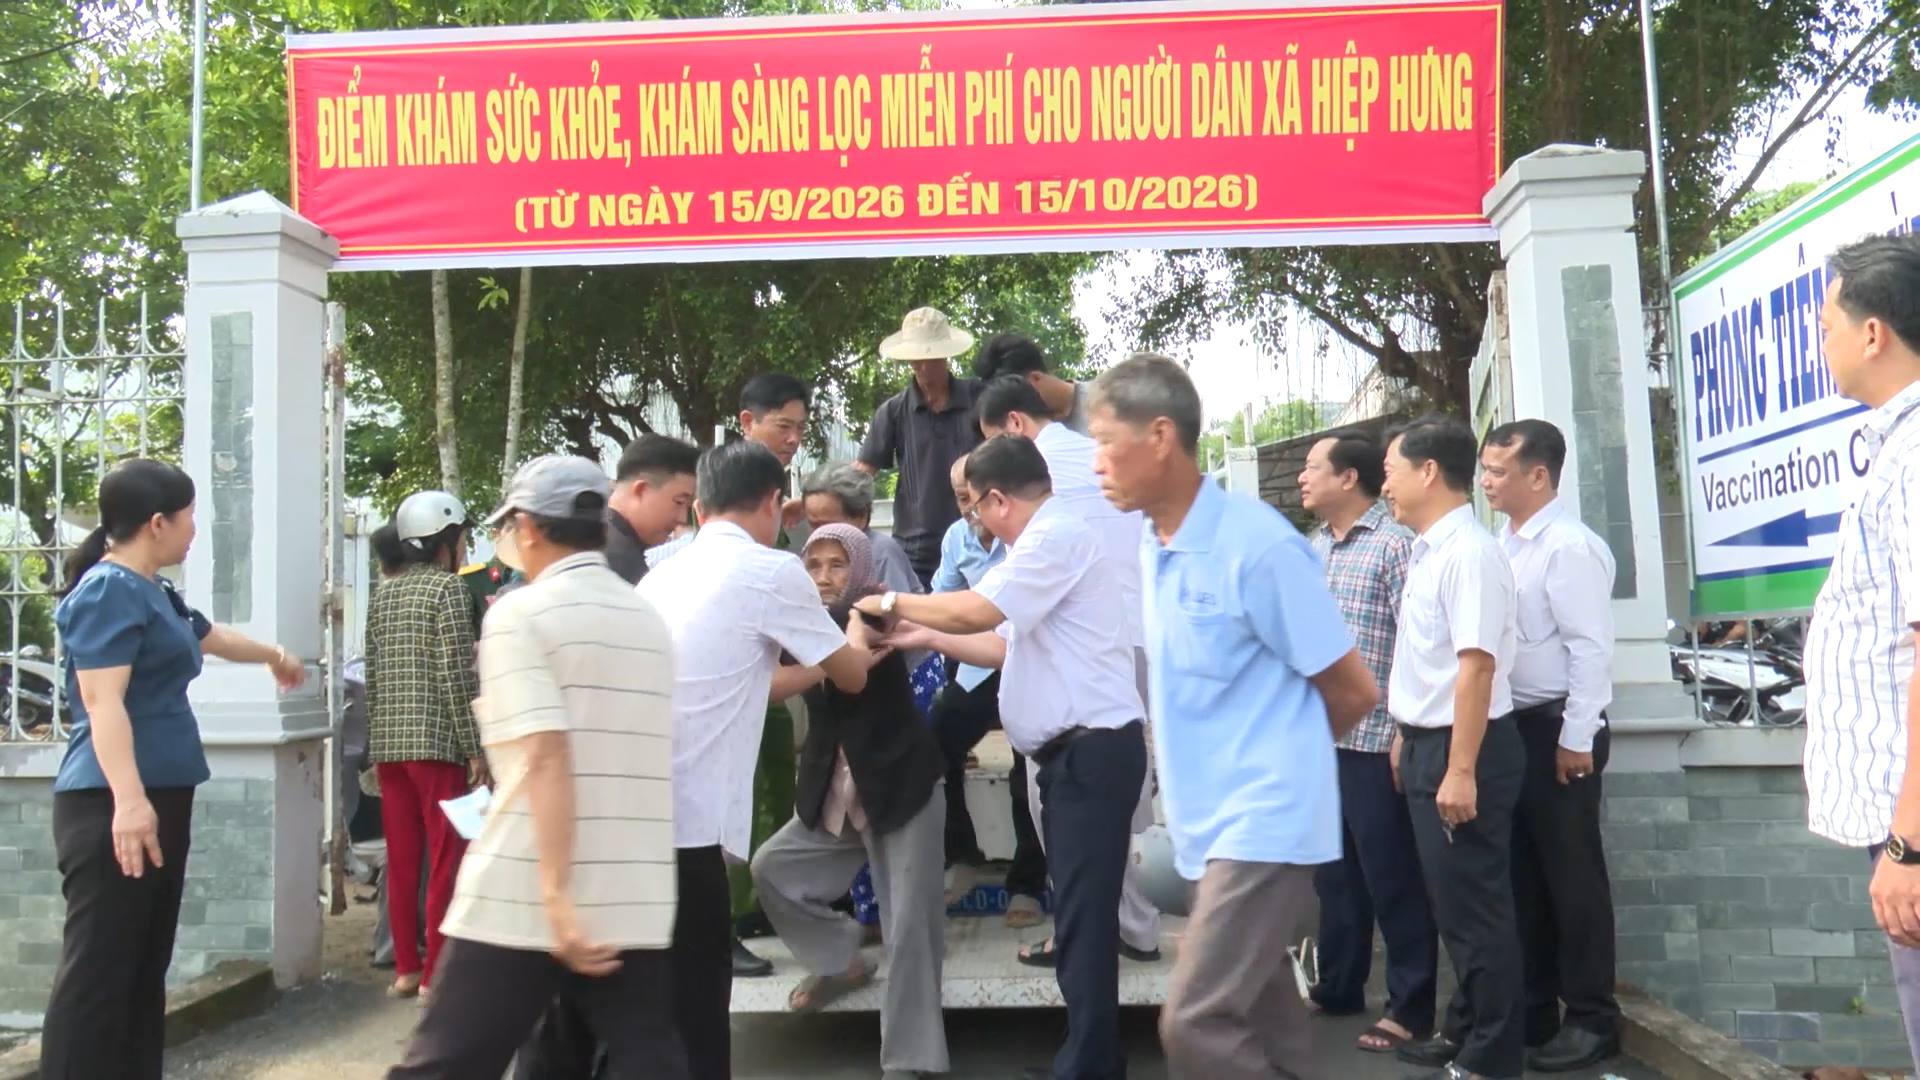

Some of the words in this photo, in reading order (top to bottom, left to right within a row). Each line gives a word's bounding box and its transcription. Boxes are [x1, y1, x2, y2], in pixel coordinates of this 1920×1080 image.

[317, 64, 388, 169] ĐIỂM
[395, 76, 478, 167] KHÁM
[485, 73, 542, 164] SỨC
[548, 60, 632, 167] KHỎE,
[639, 65, 723, 157] KHÁM
[731, 63, 810, 155] SÀNG
[818, 74, 872, 167] LỌC
[880, 44, 957, 149] MIỄN
[965, 52, 1015, 146] PHÍ
[1023, 67, 1082, 145] CHO
[1091, 44, 1182, 142] NGƯỜI
[1191, 45, 1254, 139] DÂN
[1262, 44, 1304, 136] XÃ
[1311, 40, 1380, 152] HIỆP
[1389, 45, 1473, 133] HƯNG
[514, 187, 580, 233] (TỪ
[588, 185, 694, 228] NGÀY
[709, 186, 905, 224] 15/9/2026
[917, 173, 1000, 218] ĐẾN
[1015, 174, 1258, 214] 15/10/2026)
[1690, 286, 1767, 443] PHÒNG
[1701, 446, 1840, 513] Vaccination
